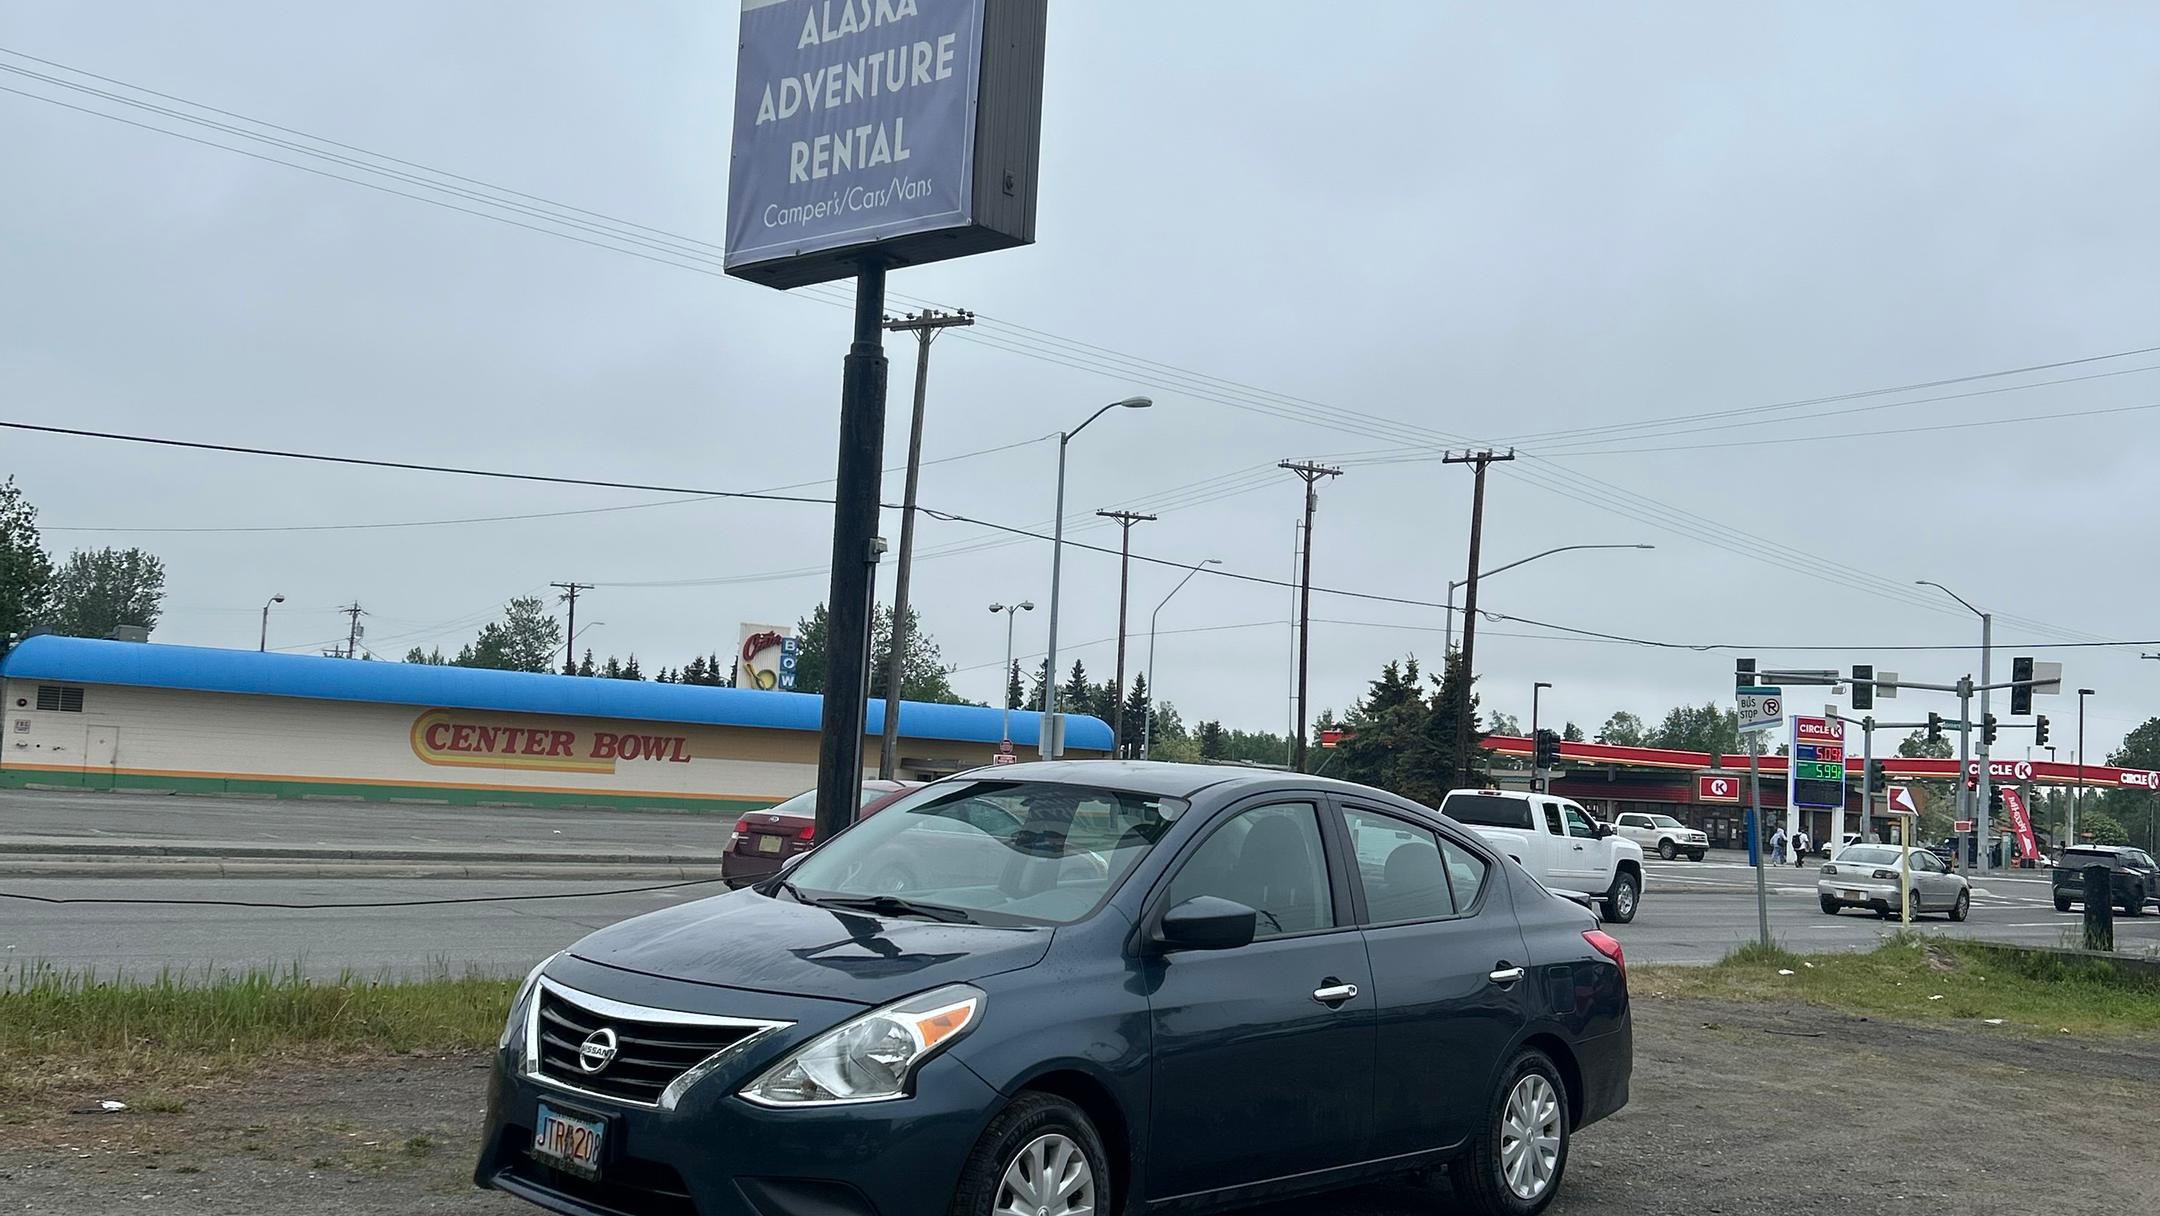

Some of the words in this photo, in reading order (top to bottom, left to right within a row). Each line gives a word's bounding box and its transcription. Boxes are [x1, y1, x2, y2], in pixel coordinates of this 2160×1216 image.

[755, 33, 956, 126] ADVENTURE
[789, 117, 910, 184] RENTAL
[1741, 698, 1756, 708] BUS
[1740, 709, 1758, 719] STOP
[1800, 724, 1829, 735] CIRCLE
[425, 723, 575, 757] CENTER
[590, 733, 691, 763] BOWL
[2016, 763, 2032, 778] K
[1713, 781, 1727, 794] K
[537, 1116, 565, 1154] JTR
[574, 1127, 601, 1164] 208
